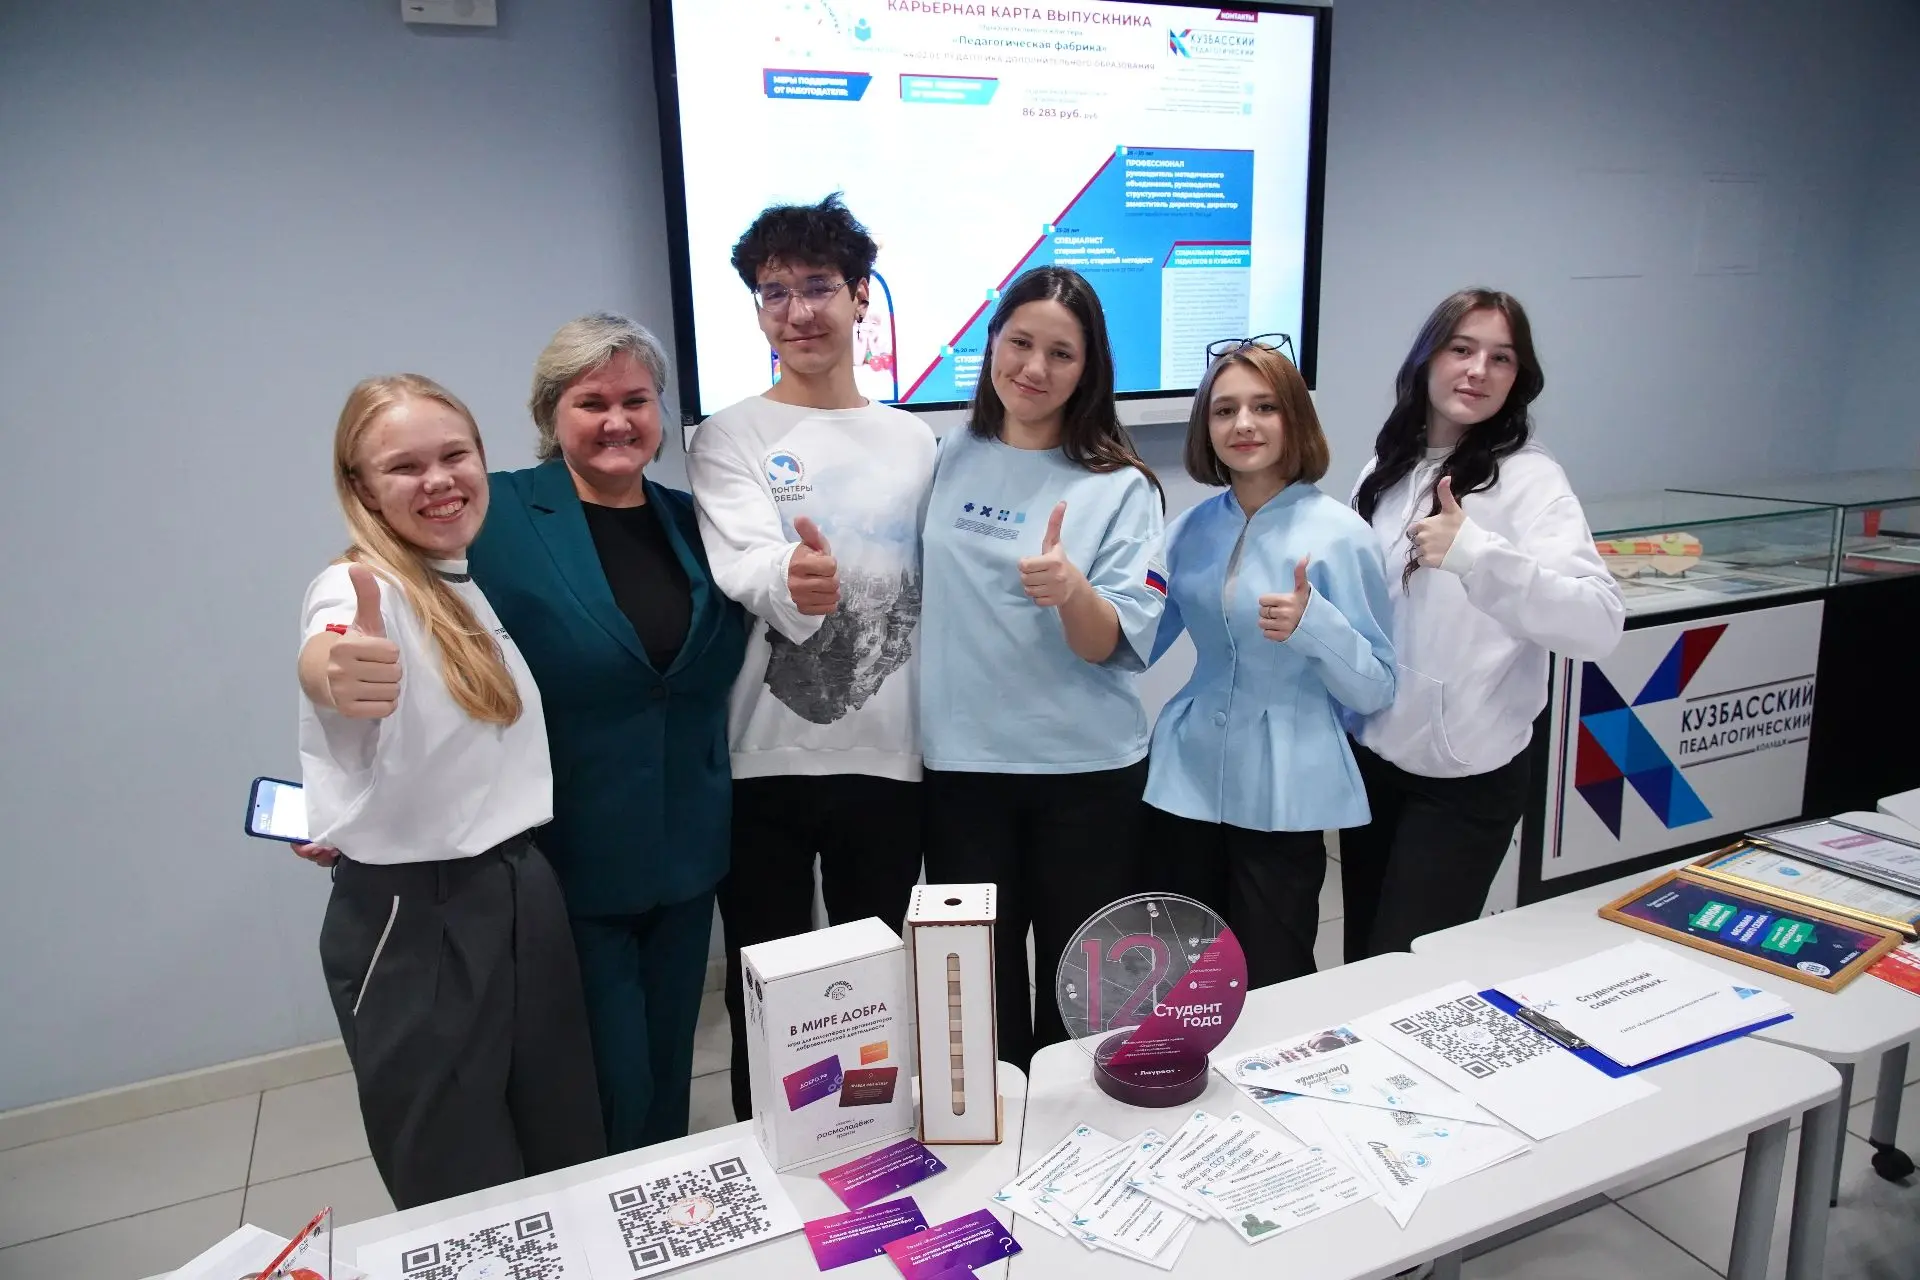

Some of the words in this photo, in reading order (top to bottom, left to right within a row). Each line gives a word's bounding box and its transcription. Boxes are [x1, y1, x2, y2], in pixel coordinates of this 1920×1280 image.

[888, 0, 986, 16] КАРЬЕРНАЯ
[991, 6, 1042, 20] КАРТА
[1047, 10, 1153, 28] ВЫПУСКНИКА
[1221, 11, 1254, 21] КОНТАКТЫ
[952, 35, 1051, 49] «Педагогическая
[1054, 41, 1108, 53] фабрика»
[1095, 60, 1155, 71] ОБРАЗОВАНИЯ
[773, 76, 797, 85] МЕРЫ
[773, 86, 785, 95] ОТ
[1021, 107, 1037, 118] 86
[1038, 108, 1056, 118] 283
[1059, 108, 1082, 120] руб.
[1126, 159, 1185, 167] ПРОФЕССИОНАЛ
[1054, 236, 1104, 245] СПЕЦИАЛИСТ
[1681, 681, 1814, 733] КУЗБАССКИЙ
[1679, 712, 1812, 755] ПЕДАГОГИЧЕСКИЙ
[1081, 933, 1171, 1034] 12
[1576, 971, 1653, 1004] Студенческий
[1589, 995, 1621, 1010] совет
[1621, 979, 1668, 1001] Первых.
[790, 1026, 798, 1036] В
[802, 1014, 838, 1033] МИРЕ
[841, 1002, 887, 1024] ДОБРА
[1153, 1001, 1223, 1020] Студент
[1183, 1015, 1222, 1028] года
[1177, 1159, 1203, 1181] Великая
[1201, 1128, 1245, 1163] Отечественная
[1209, 1154, 1226, 1169] СССР
[1213, 1168, 1226, 1180] мая
[1224, 1156, 1241, 1171] 1945
[1238, 1146, 1254, 1161] года
